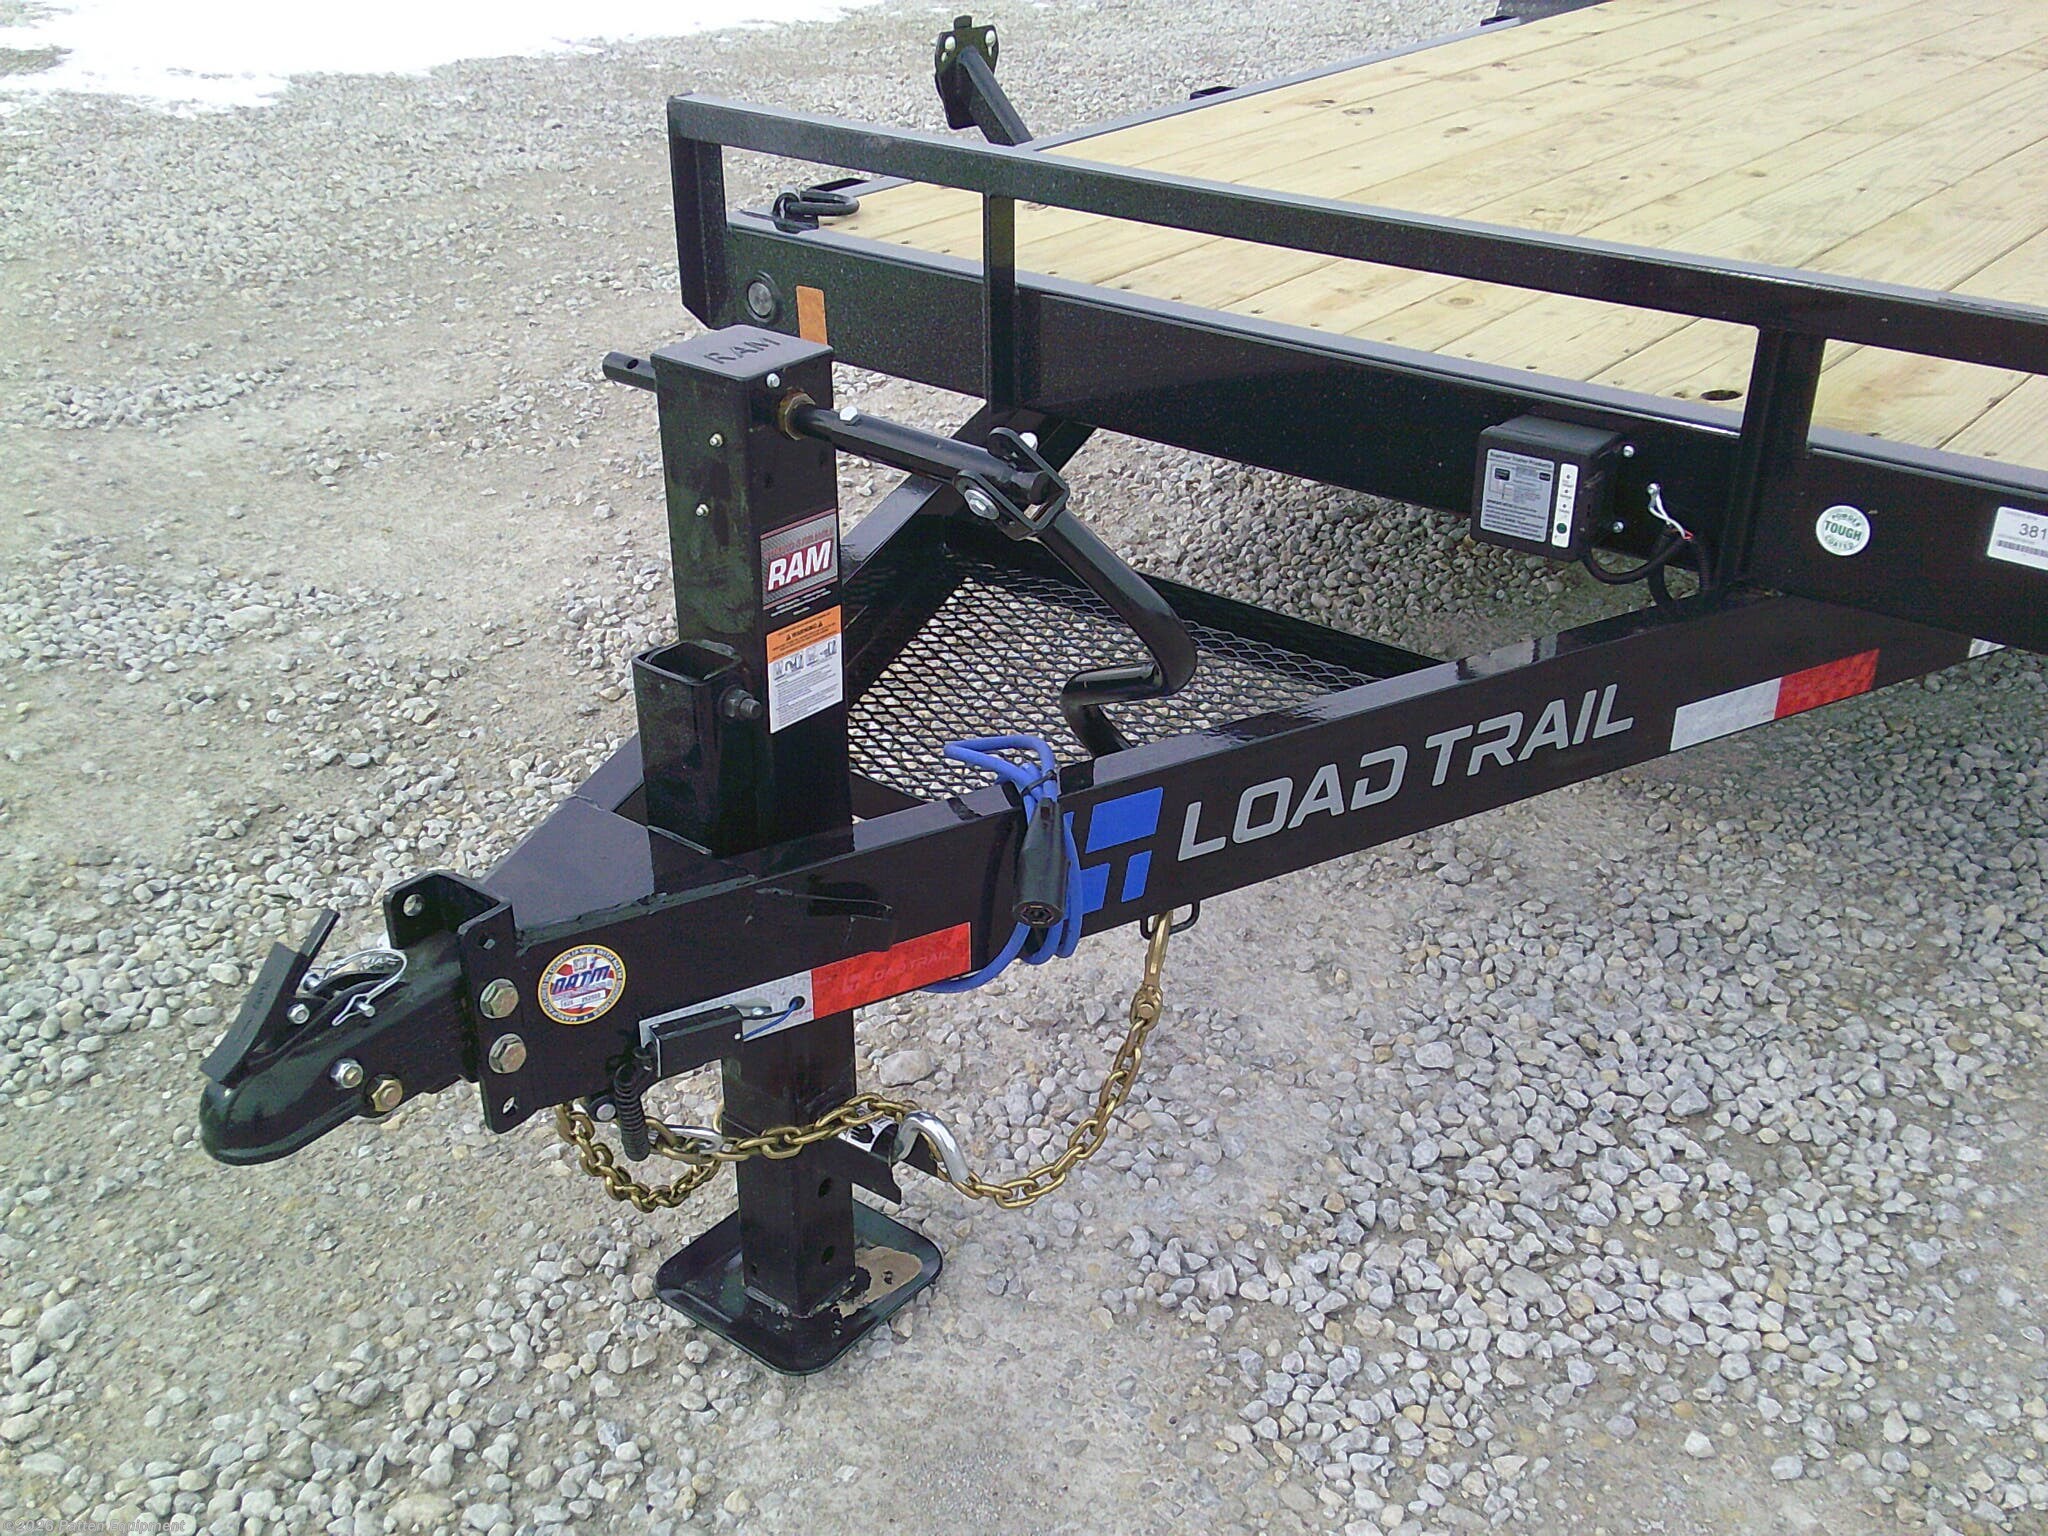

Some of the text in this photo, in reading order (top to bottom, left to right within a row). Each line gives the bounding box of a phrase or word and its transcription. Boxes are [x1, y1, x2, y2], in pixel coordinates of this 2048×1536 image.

[704, 337, 780, 364] RAM
[1825, 521, 1862, 541] TOUGH
[2019, 523, 2048, 541] 381
[767, 540, 831, 592] RAM
[1178, 683, 1634, 861] LOAD TRAIL
